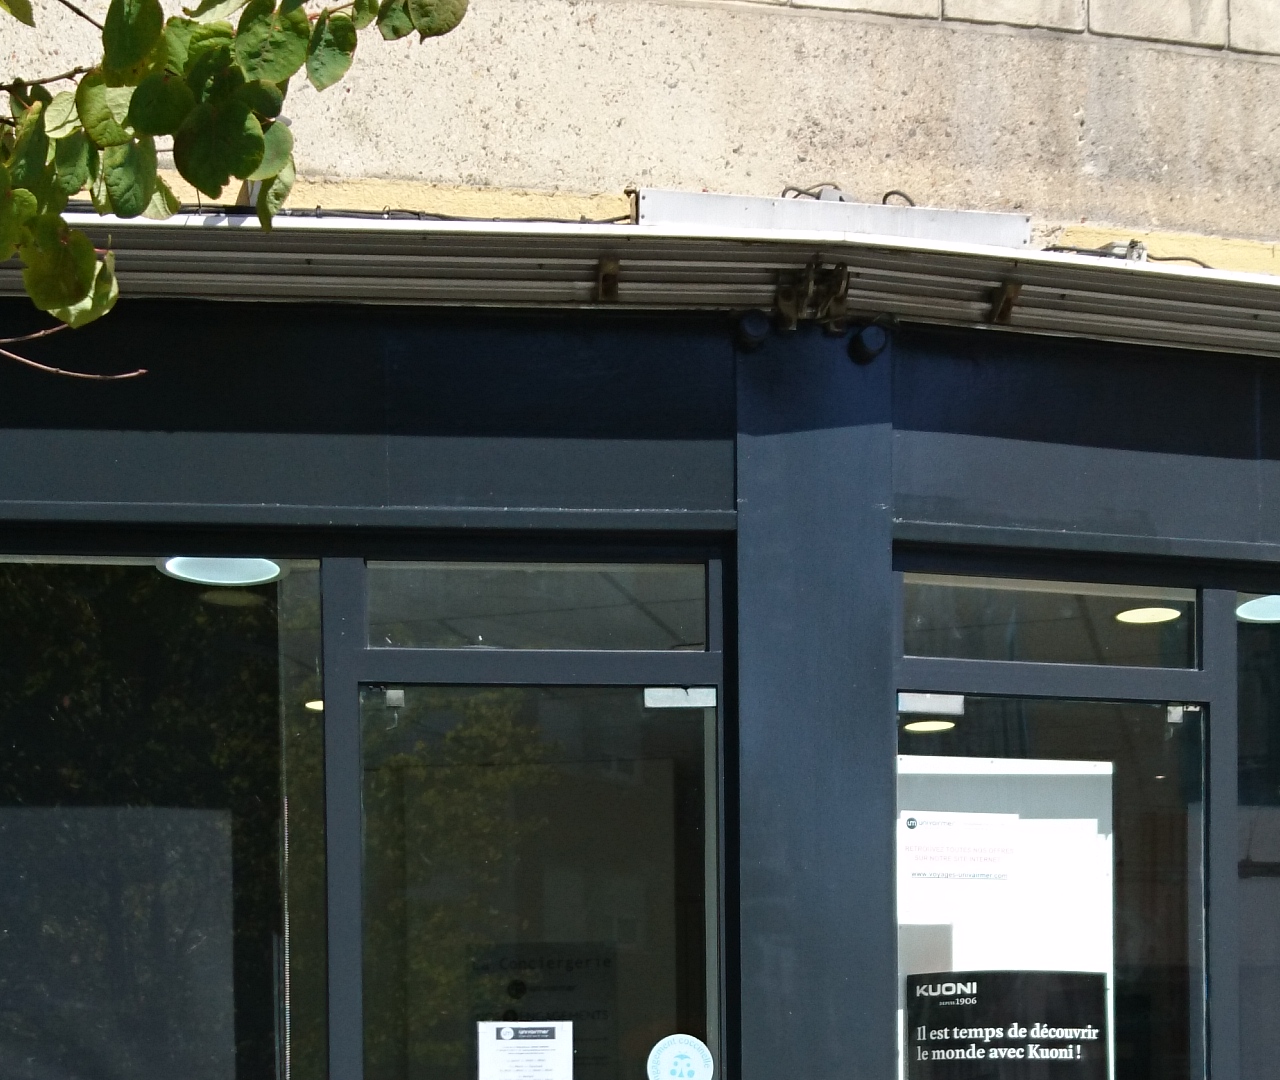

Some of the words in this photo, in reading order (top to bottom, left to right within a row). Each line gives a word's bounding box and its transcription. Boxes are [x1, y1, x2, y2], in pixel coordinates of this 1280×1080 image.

[916, 981, 978, 997] KUONI
[955, 997, 977, 1006] 1906
[917, 1025, 927, 1041] Il
[929, 1026, 950, 1040] est
[953, 1025, 1004, 1043] temps
[1008, 1023, 1028, 1039] de
[1030, 1022, 1099, 1040] découvrir
[917, 1045, 929, 1061] le
[931, 1044, 986, 1060] monde
[989, 1047, 1025, 1060] avec
